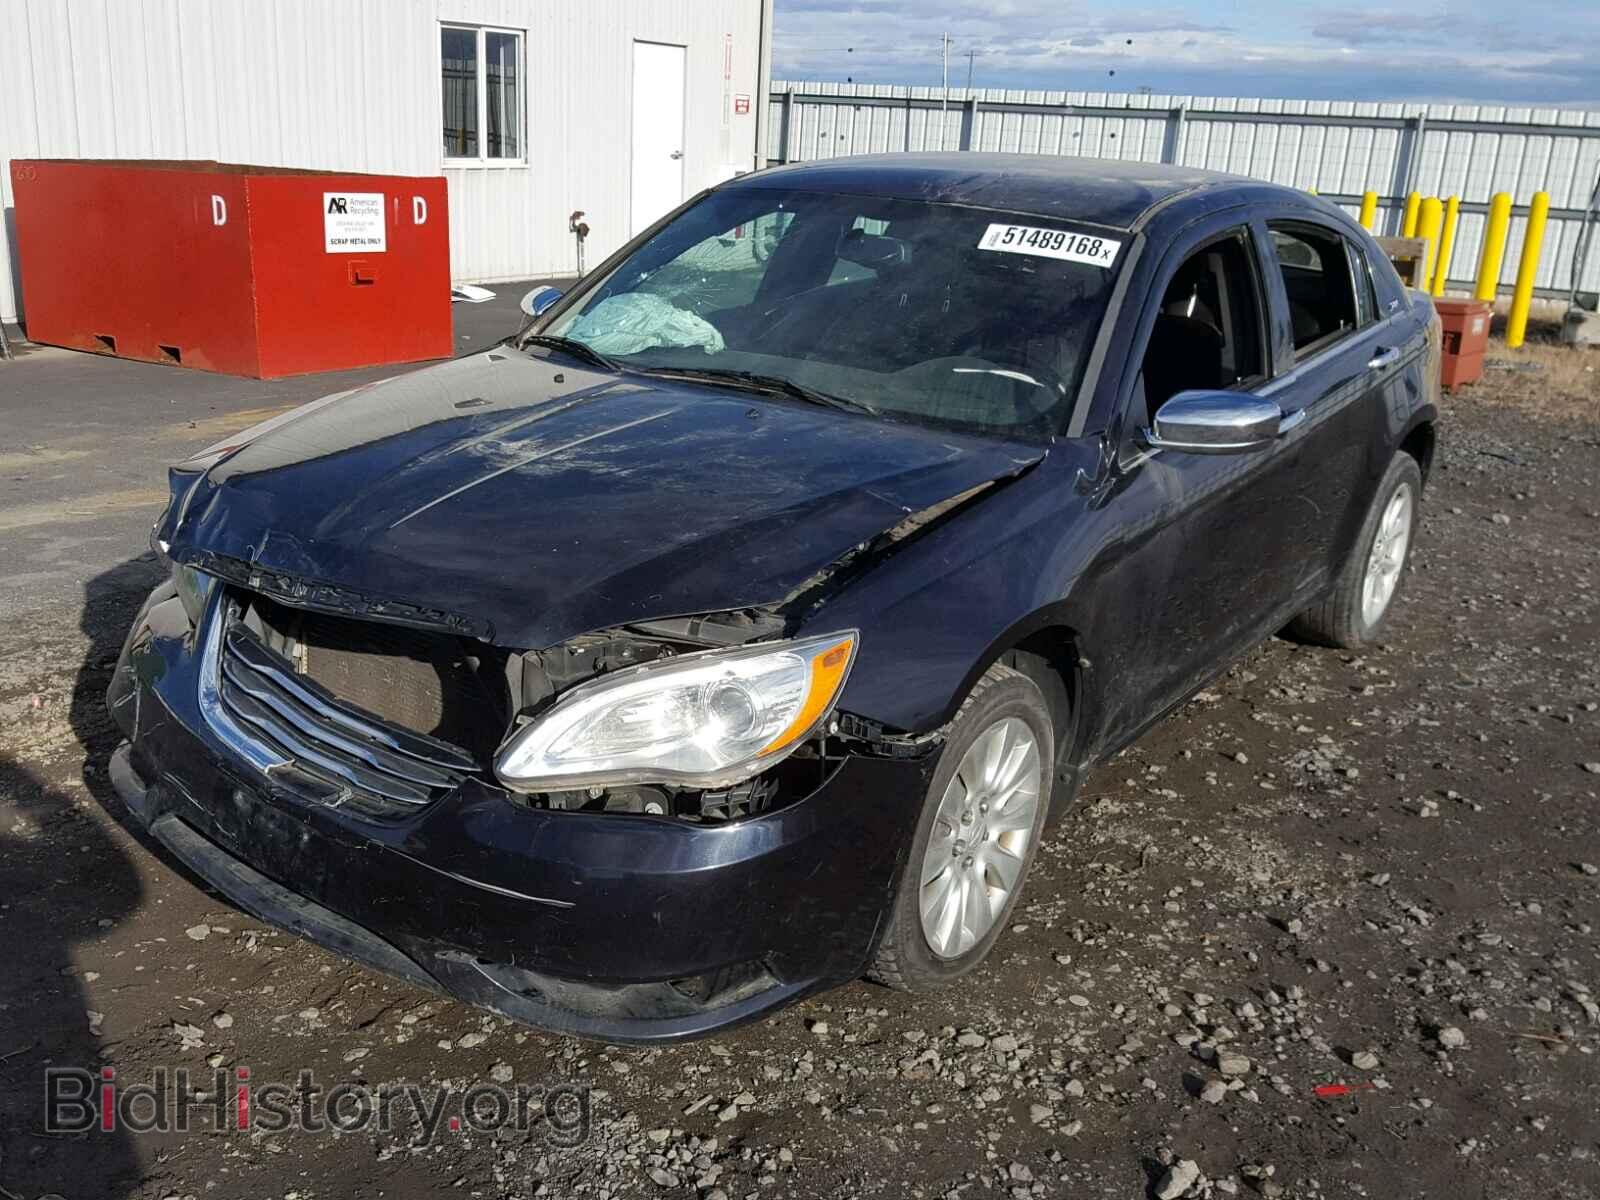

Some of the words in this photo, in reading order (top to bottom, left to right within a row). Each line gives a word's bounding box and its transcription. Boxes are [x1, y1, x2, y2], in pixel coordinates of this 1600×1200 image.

[211, 195, 227, 226] D
[350, 198, 378, 206] American
[350, 206, 380, 216] Recycling
[413, 196, 427, 224] D
